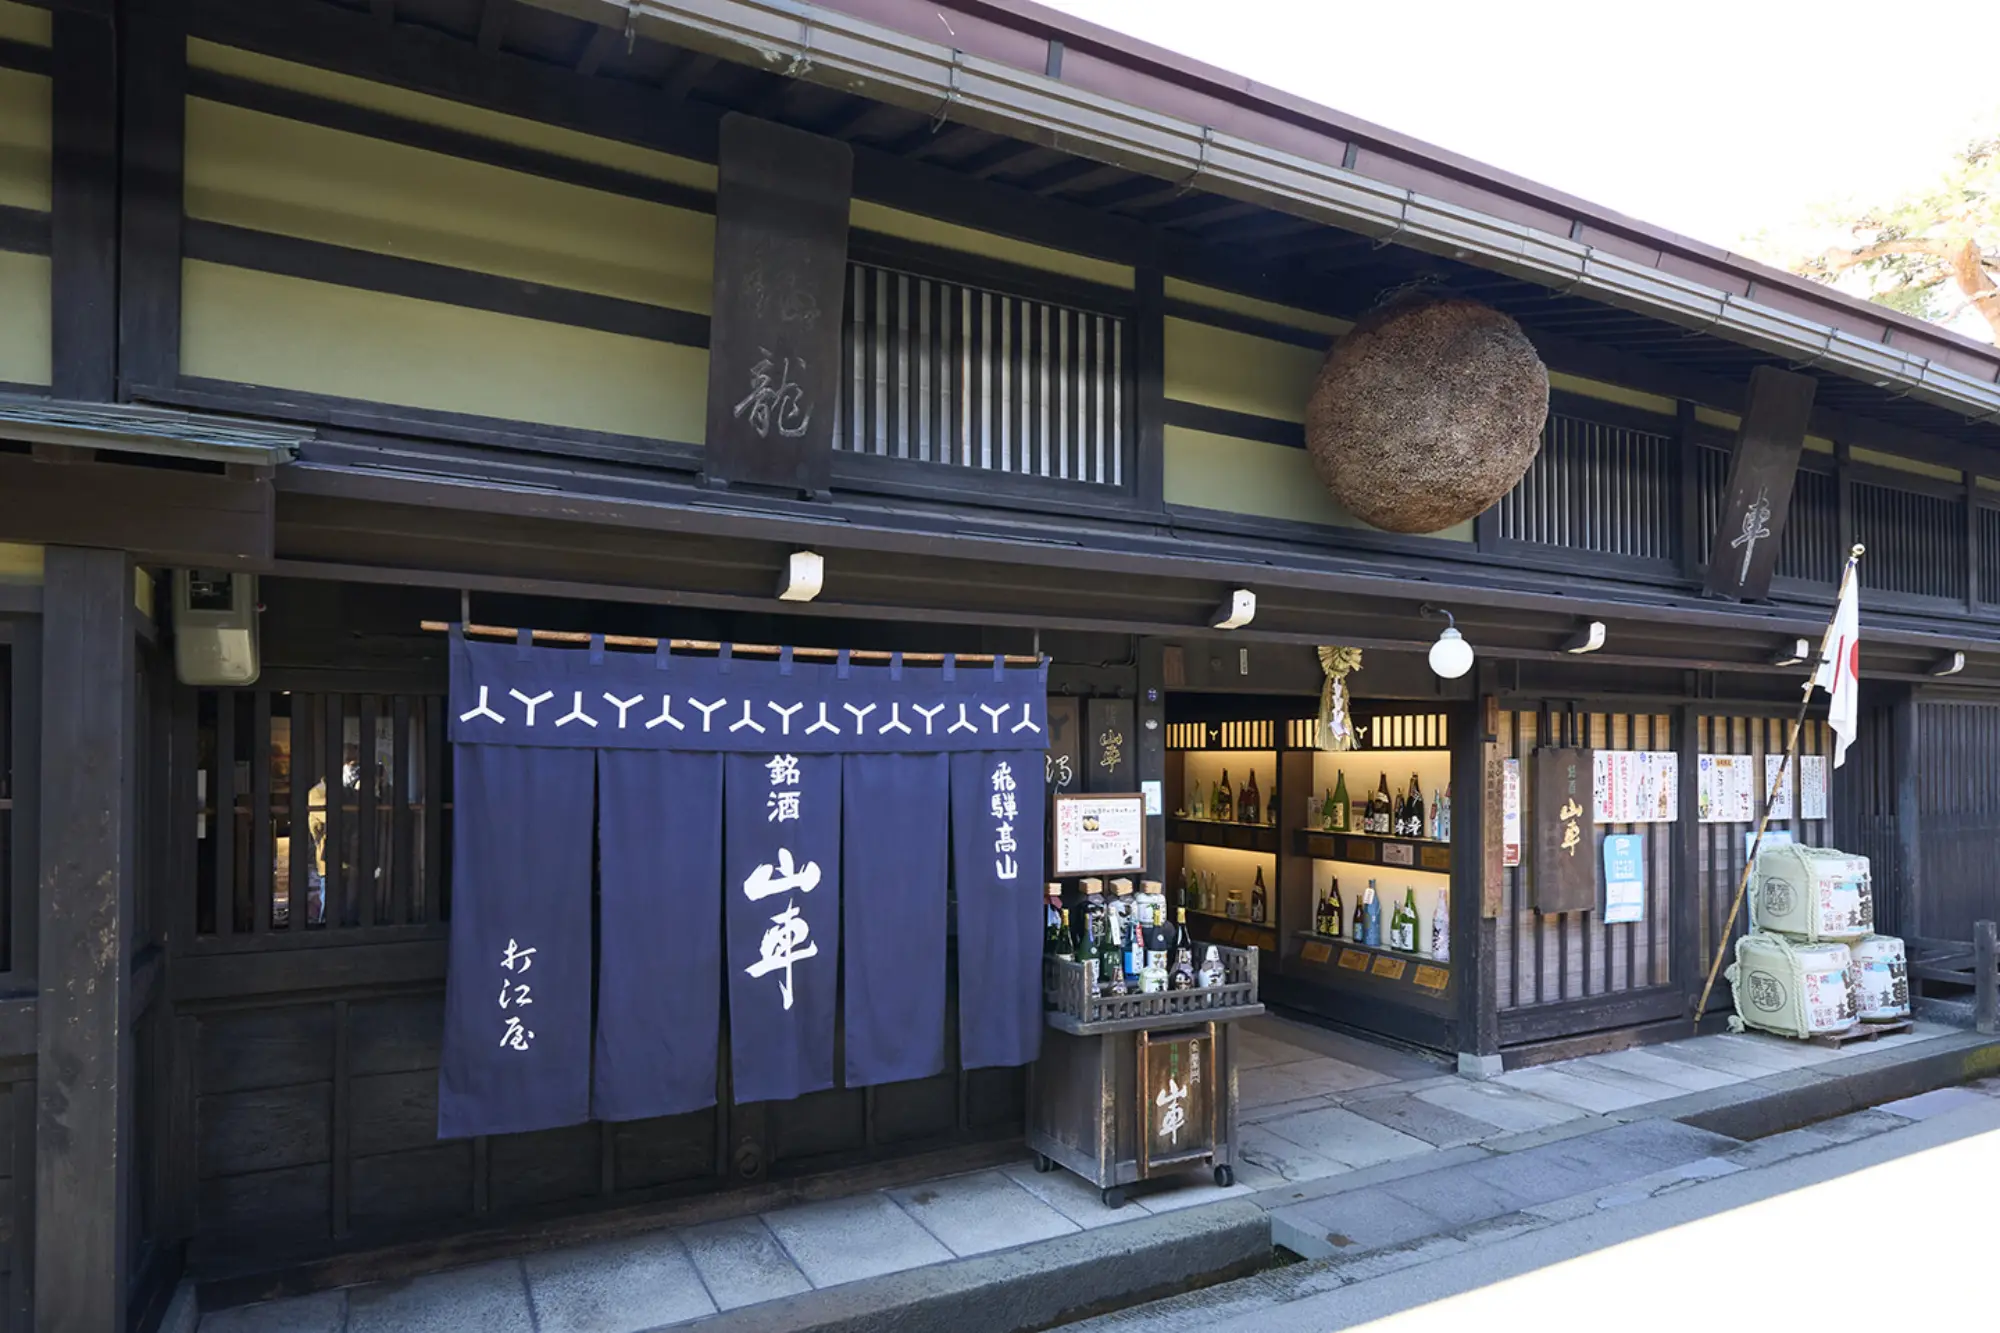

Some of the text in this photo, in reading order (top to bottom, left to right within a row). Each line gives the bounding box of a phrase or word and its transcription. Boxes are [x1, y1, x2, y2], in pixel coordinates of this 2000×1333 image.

[764, 753, 801, 823] 銘酒
[1556, 797, 1584, 857] 山車
[742, 847, 823, 1011] 山車
[1155, 1077, 1189, 1145] 山車
